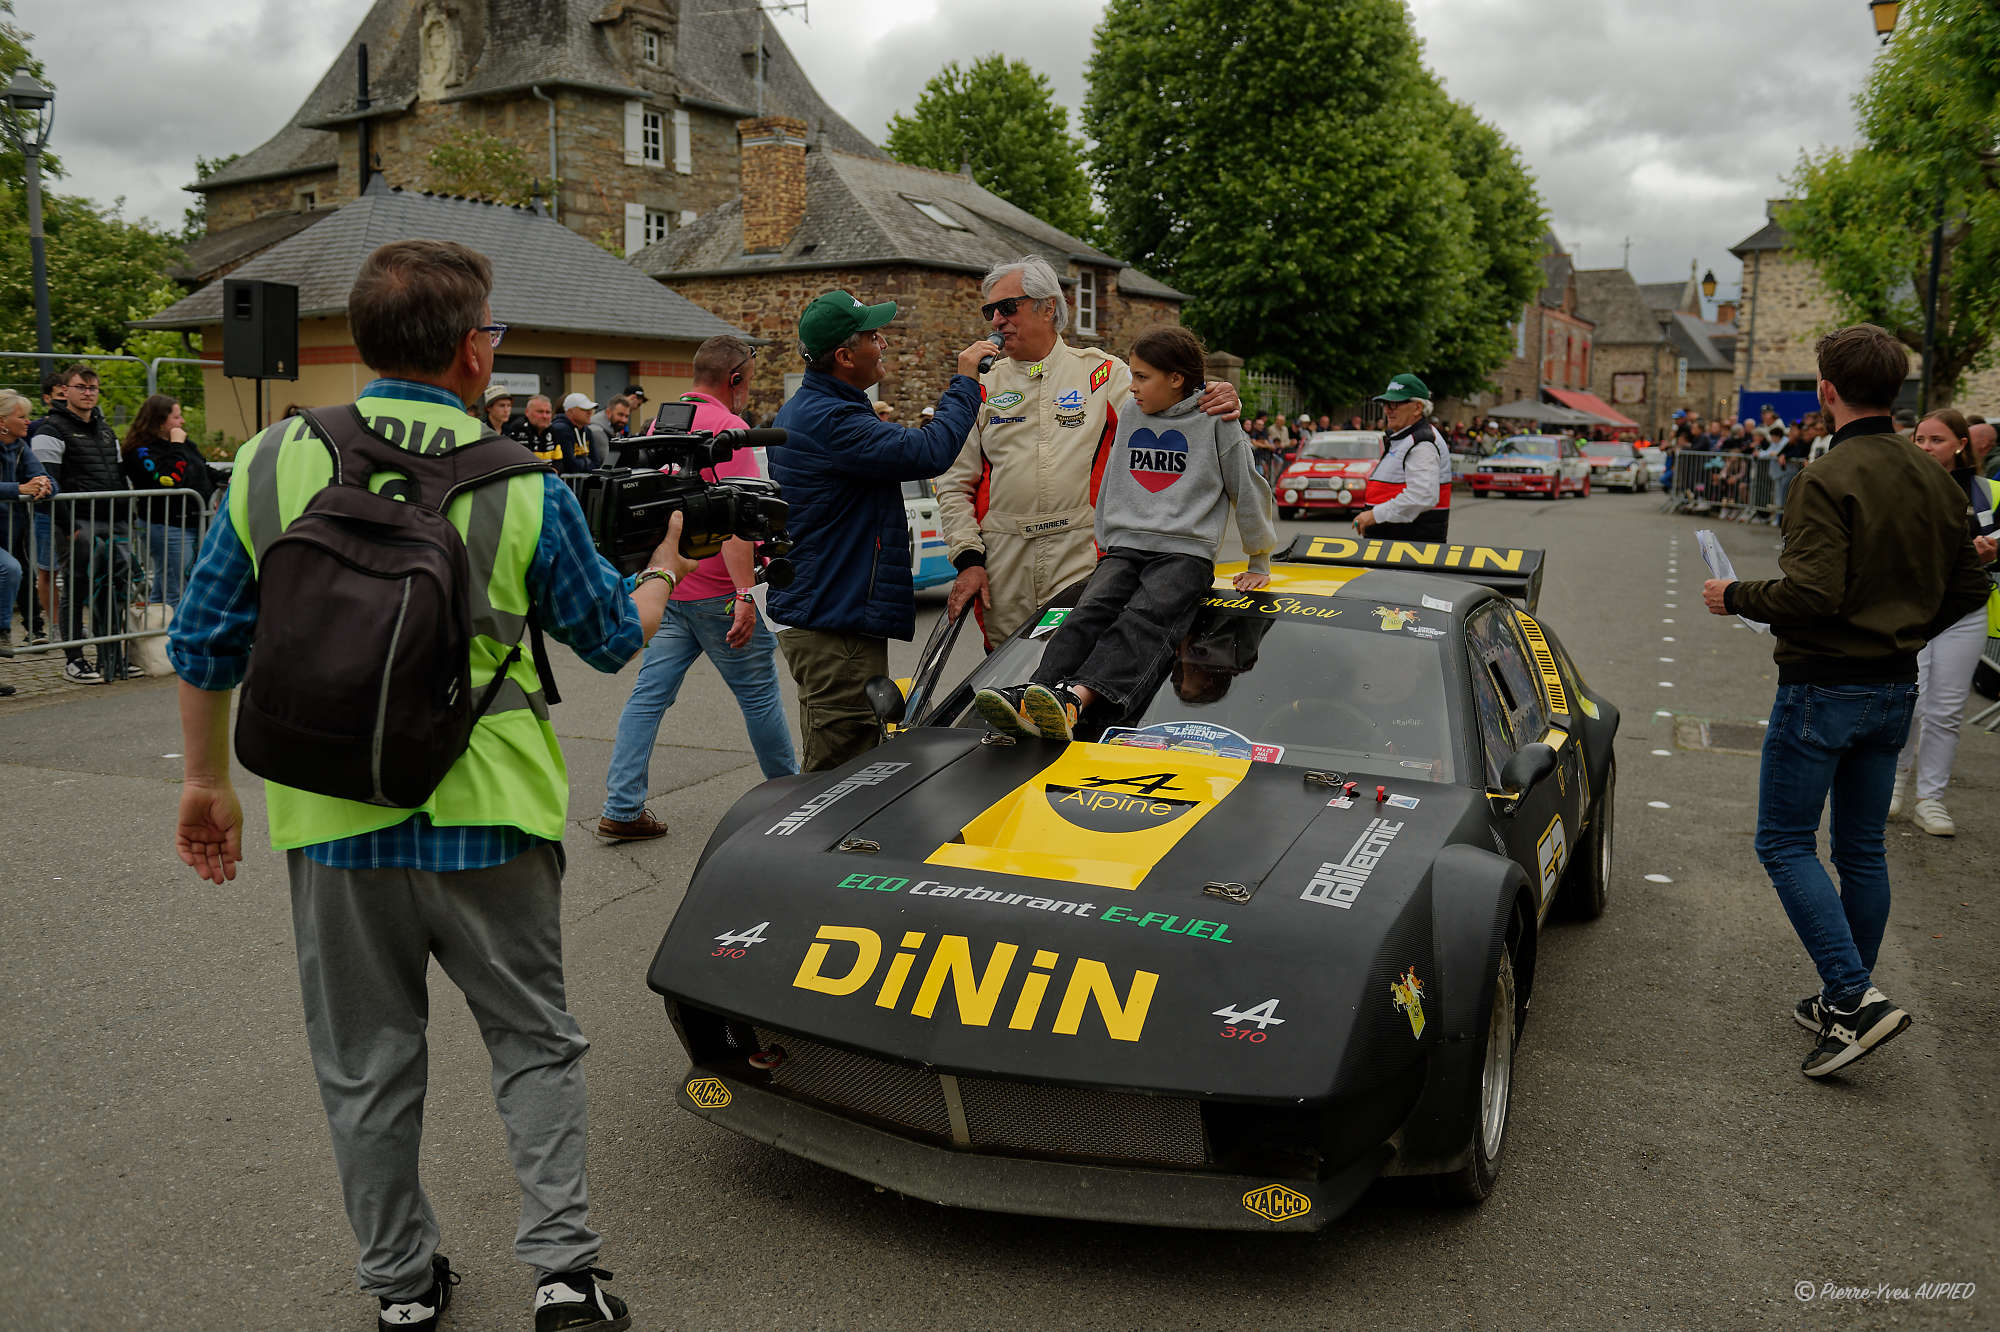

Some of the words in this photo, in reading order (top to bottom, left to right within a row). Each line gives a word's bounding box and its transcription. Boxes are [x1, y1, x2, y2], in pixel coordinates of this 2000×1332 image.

[993, 395, 1019, 403] YACCO
[1129, 450, 1187, 473] PARIS
[622, 481, 639, 489] SONY
[1035, 518, 1069, 531] TARRIERE
[1306, 537, 1524, 571] DiNiN
[1049, 613, 1064, 624] 2
[1259, 598, 1344, 619] Show
[1173, 727, 1218, 740] LEGEND
[1059, 789, 1172, 816] Alpine
[837, 873, 910, 892] ECO
[909, 881, 1098, 917] Carburant
[1100, 905, 1233, 944] E-FUEL
[711, 946, 748, 960] 310
[792, 925, 1160, 1042] DiNiN
[1219, 1026, 1268, 1043] 310
[691, 1082, 726, 1104] YACCO
[1247, 1189, 1302, 1217] YACCO
